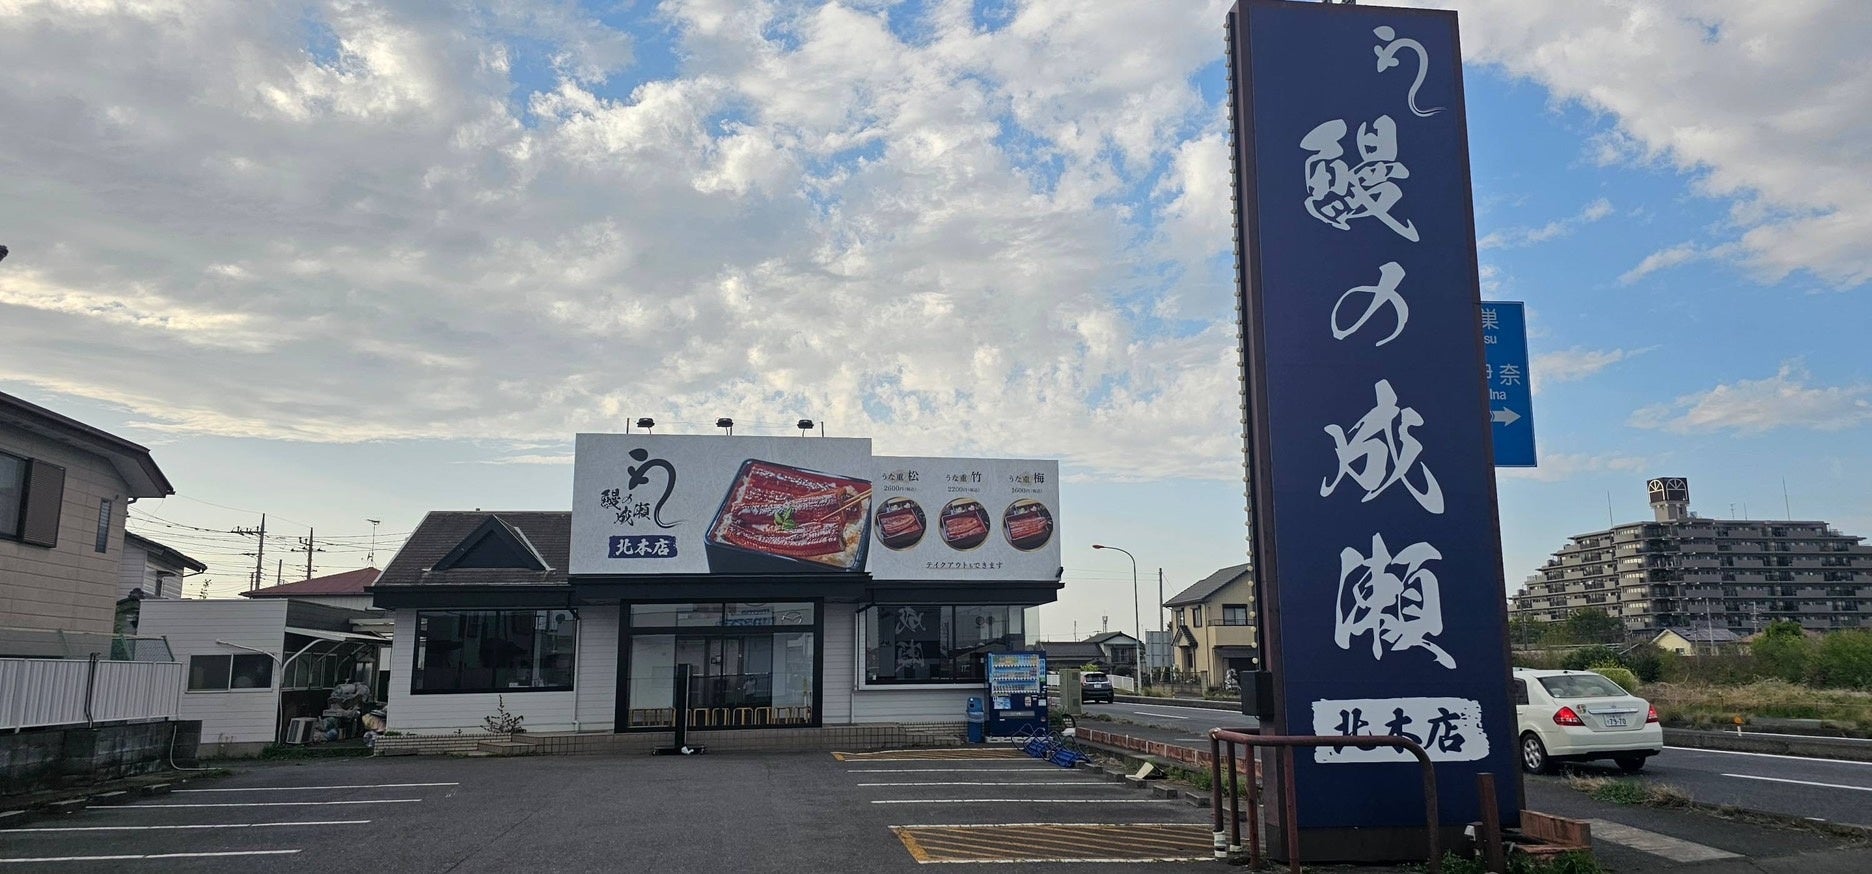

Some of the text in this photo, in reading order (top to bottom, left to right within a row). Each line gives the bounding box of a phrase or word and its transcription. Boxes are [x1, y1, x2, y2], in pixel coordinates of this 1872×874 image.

[1299, 114, 1457, 669] 鰻の成瀬
[1489, 388, 1507, 400] Ina
[908, 469, 920, 481] 松
[971, 471, 982, 483] 竹
[1034, 472, 1045, 483] 梅
[615, 538, 670, 556] 北本店
